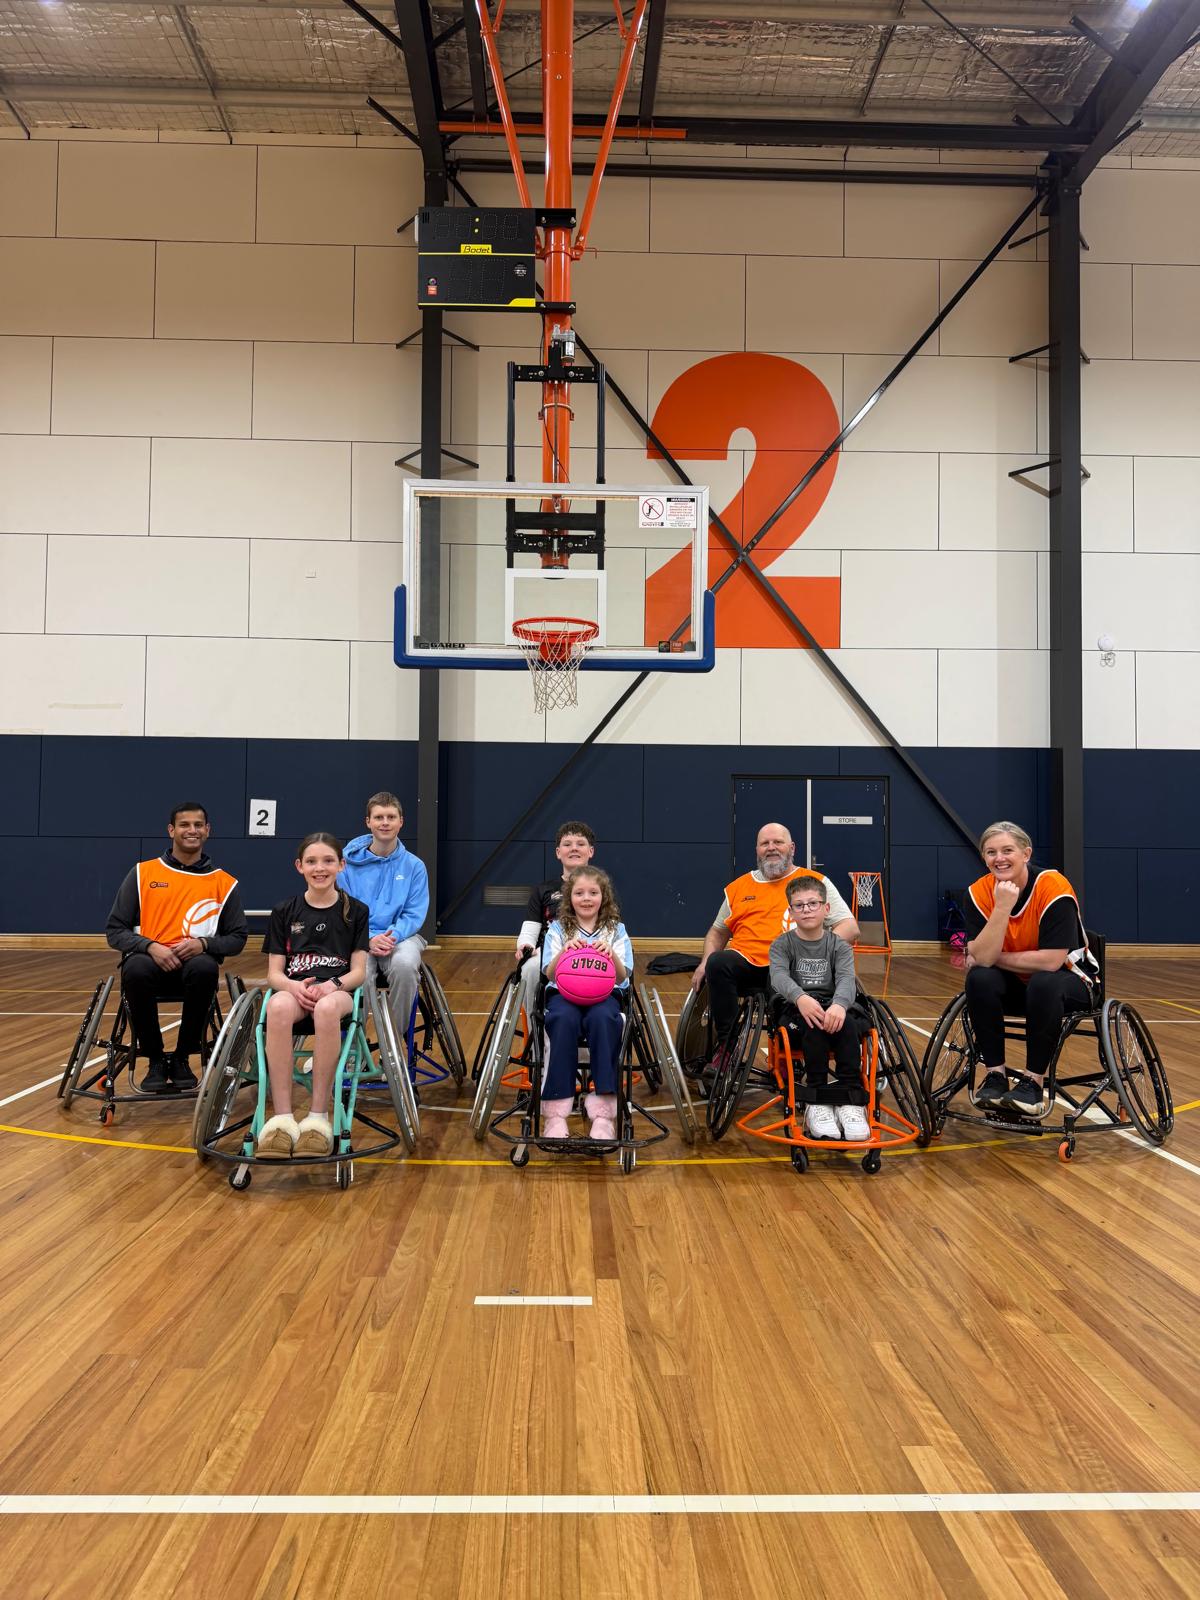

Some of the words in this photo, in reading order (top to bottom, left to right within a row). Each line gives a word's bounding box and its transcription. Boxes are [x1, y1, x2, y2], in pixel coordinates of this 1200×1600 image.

[464, 245, 490, 253] Bodet
[644, 352, 841, 649] 2
[256, 809, 269, 826] 2
[571, 957, 608, 972] BBALR
